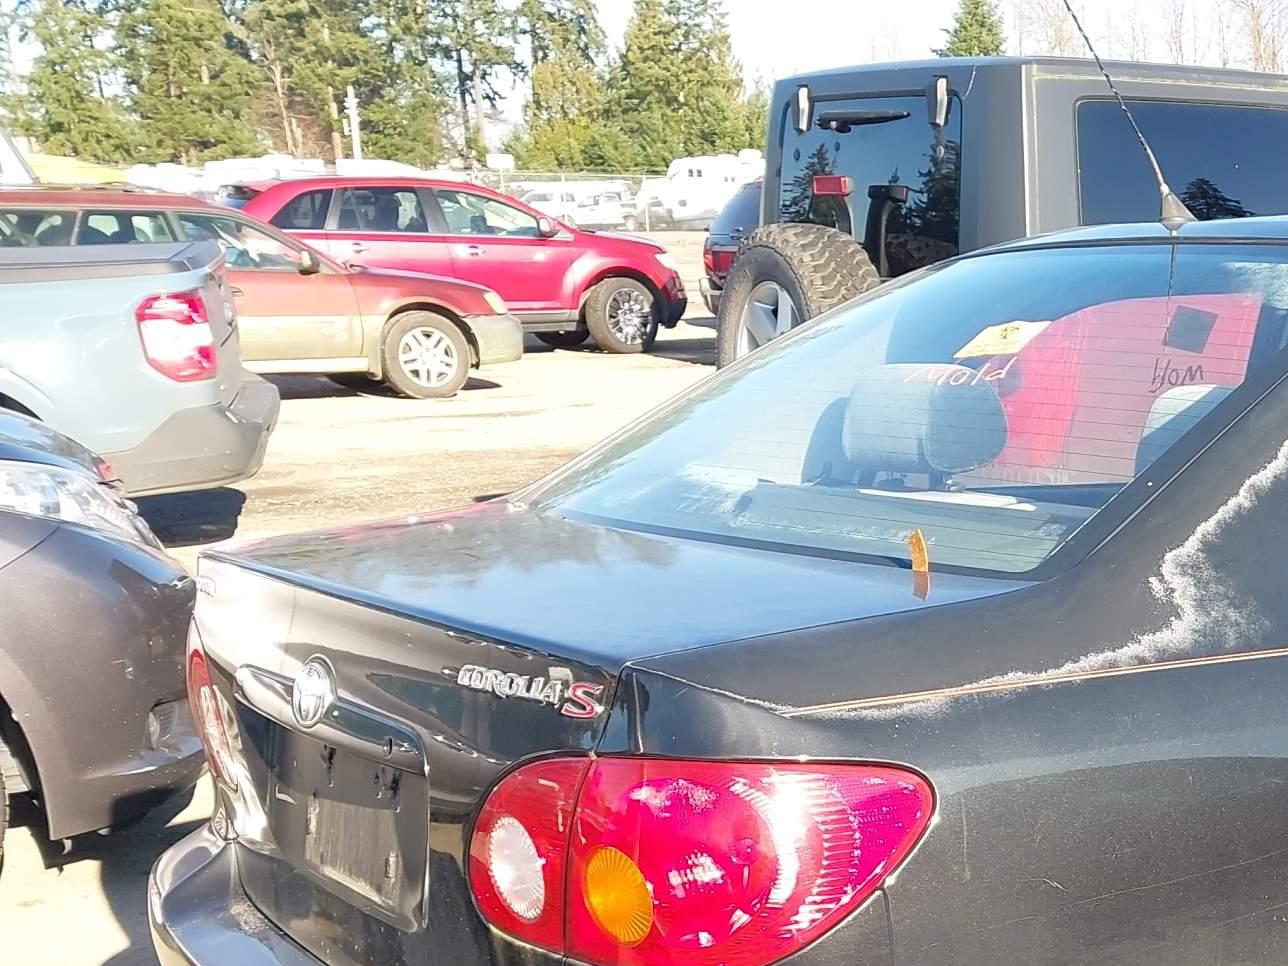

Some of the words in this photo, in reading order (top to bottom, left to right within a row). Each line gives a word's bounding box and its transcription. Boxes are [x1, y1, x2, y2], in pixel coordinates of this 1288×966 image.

[904, 356, 1018, 386] Mold
[457, 664, 562, 708] COROLLA
[561, 681, 605, 719] S
